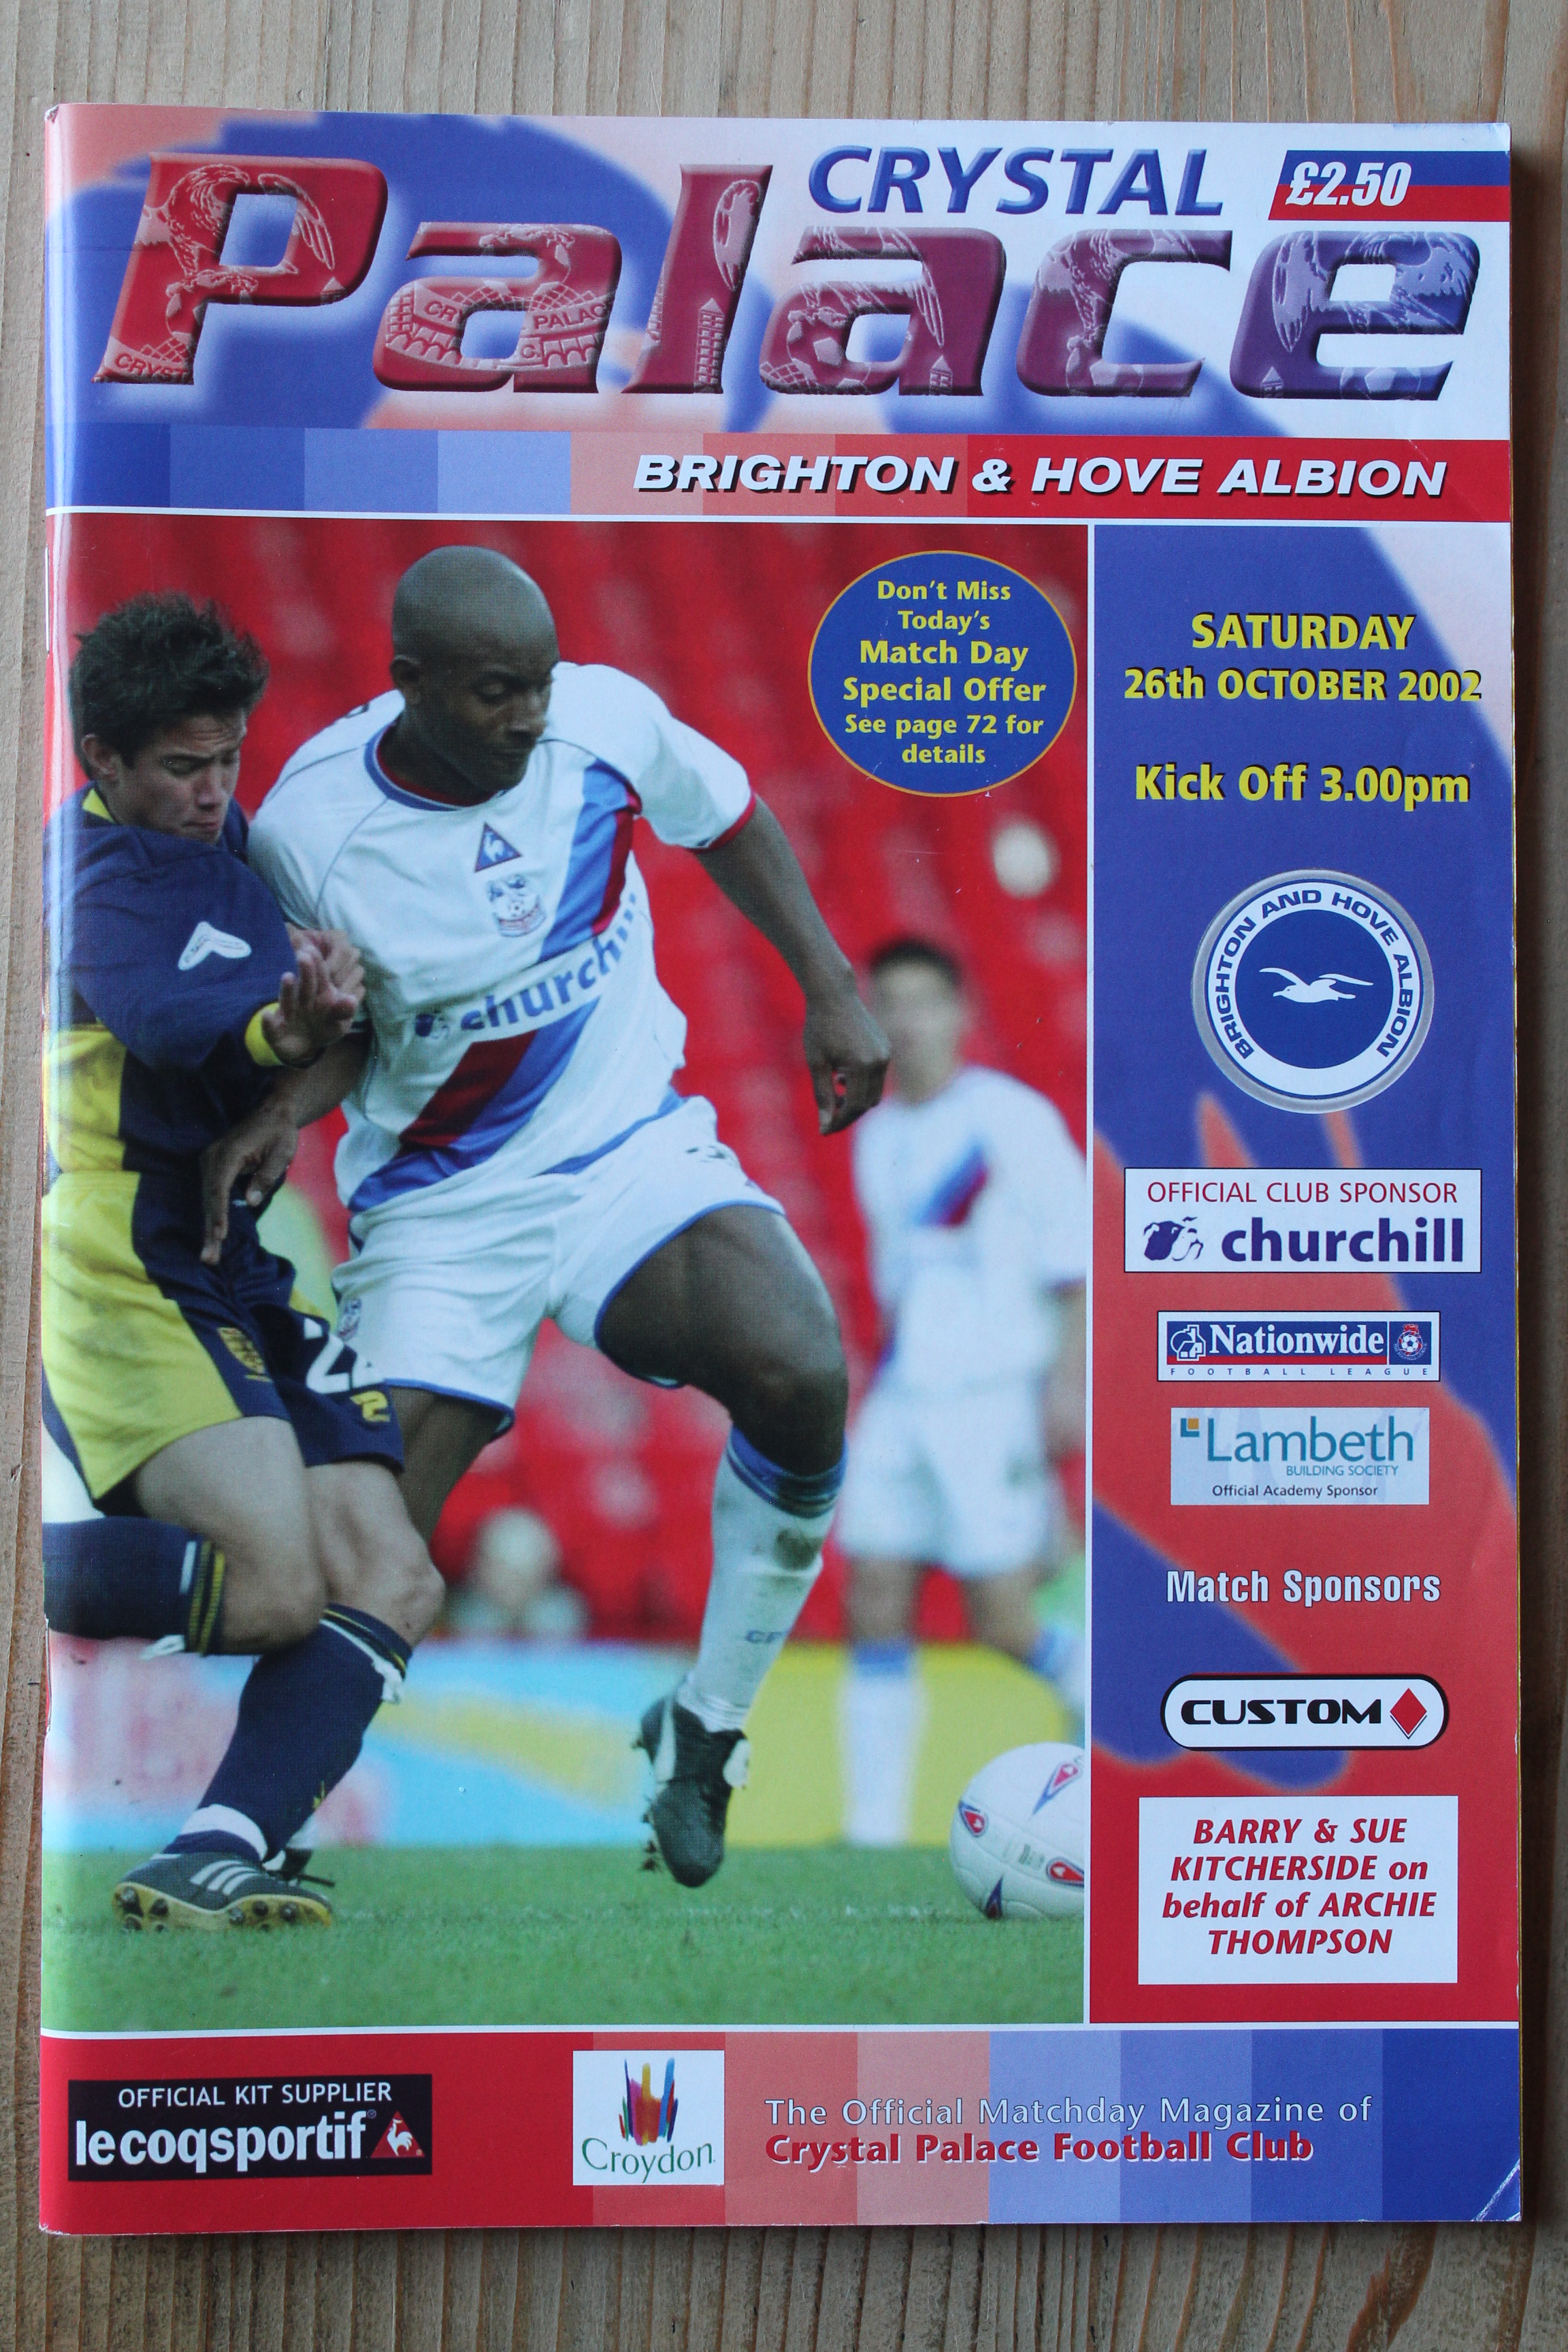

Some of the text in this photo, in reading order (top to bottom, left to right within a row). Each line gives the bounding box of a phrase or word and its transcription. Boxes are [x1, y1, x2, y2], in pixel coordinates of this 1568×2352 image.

[808, 146, 1224, 216] CRYSTAL
[1284, 161, 1413, 207] £2.50
[91, 151, 1481, 400] Palace
[633, 453, 1447, 495] BRIGHTON & HOVE ALBION
[878, 580, 1011, 600] Don't Miss
[898, 609, 990, 633] Today's
[1192, 614, 1415, 649] SATURDAY
[860, 639, 1028, 671] Match Day
[843, 676, 1046, 706] Special Offer
[1124, 667, 1480, 702] 26th OCTOBER 2002
[846, 714, 1044, 739] See page 72 for
[902, 743, 985, 763] details
[1136, 764, 1469, 812] Kick Off 3.00pm
[1215, 889, 1414, 1059] BRIGHTON AND HOVE ALBION
[1148, 1182, 1456, 1202] OFFICIAL CLUB SPONSOR
[1222, 1216, 1464, 1262] churchill
[1209, 1324, 1384, 1354] Nationwide
[1207, 1414, 1415, 1463] Lambeth
[1286, 1464, 1399, 1477] BUILDING SOCIETY
[1212, 1484, 1379, 1499] Official Academy Sponsor
[1167, 1569, 1440, 1607] Match Sponsors
[1181, 1699, 1382, 1725] CUSTOM
[1194, 1818, 1407, 1844] BARRY & SUE
[1171, 1855, 1428, 1880] KITCHERSIDE on
[1162, 1891, 1437, 1918] behalf of ARCHIE
[1209, 1929, 1392, 1954] THOMPSON
[118, 2082, 391, 2108] OFFICIAL KIT SUPPLIER
[764, 2095, 1373, 2131] The Official Matchday Magazine of
[581, 2138, 713, 2184] Croydon
[765, 2130, 1315, 2173] Crystal Palace Football Club
